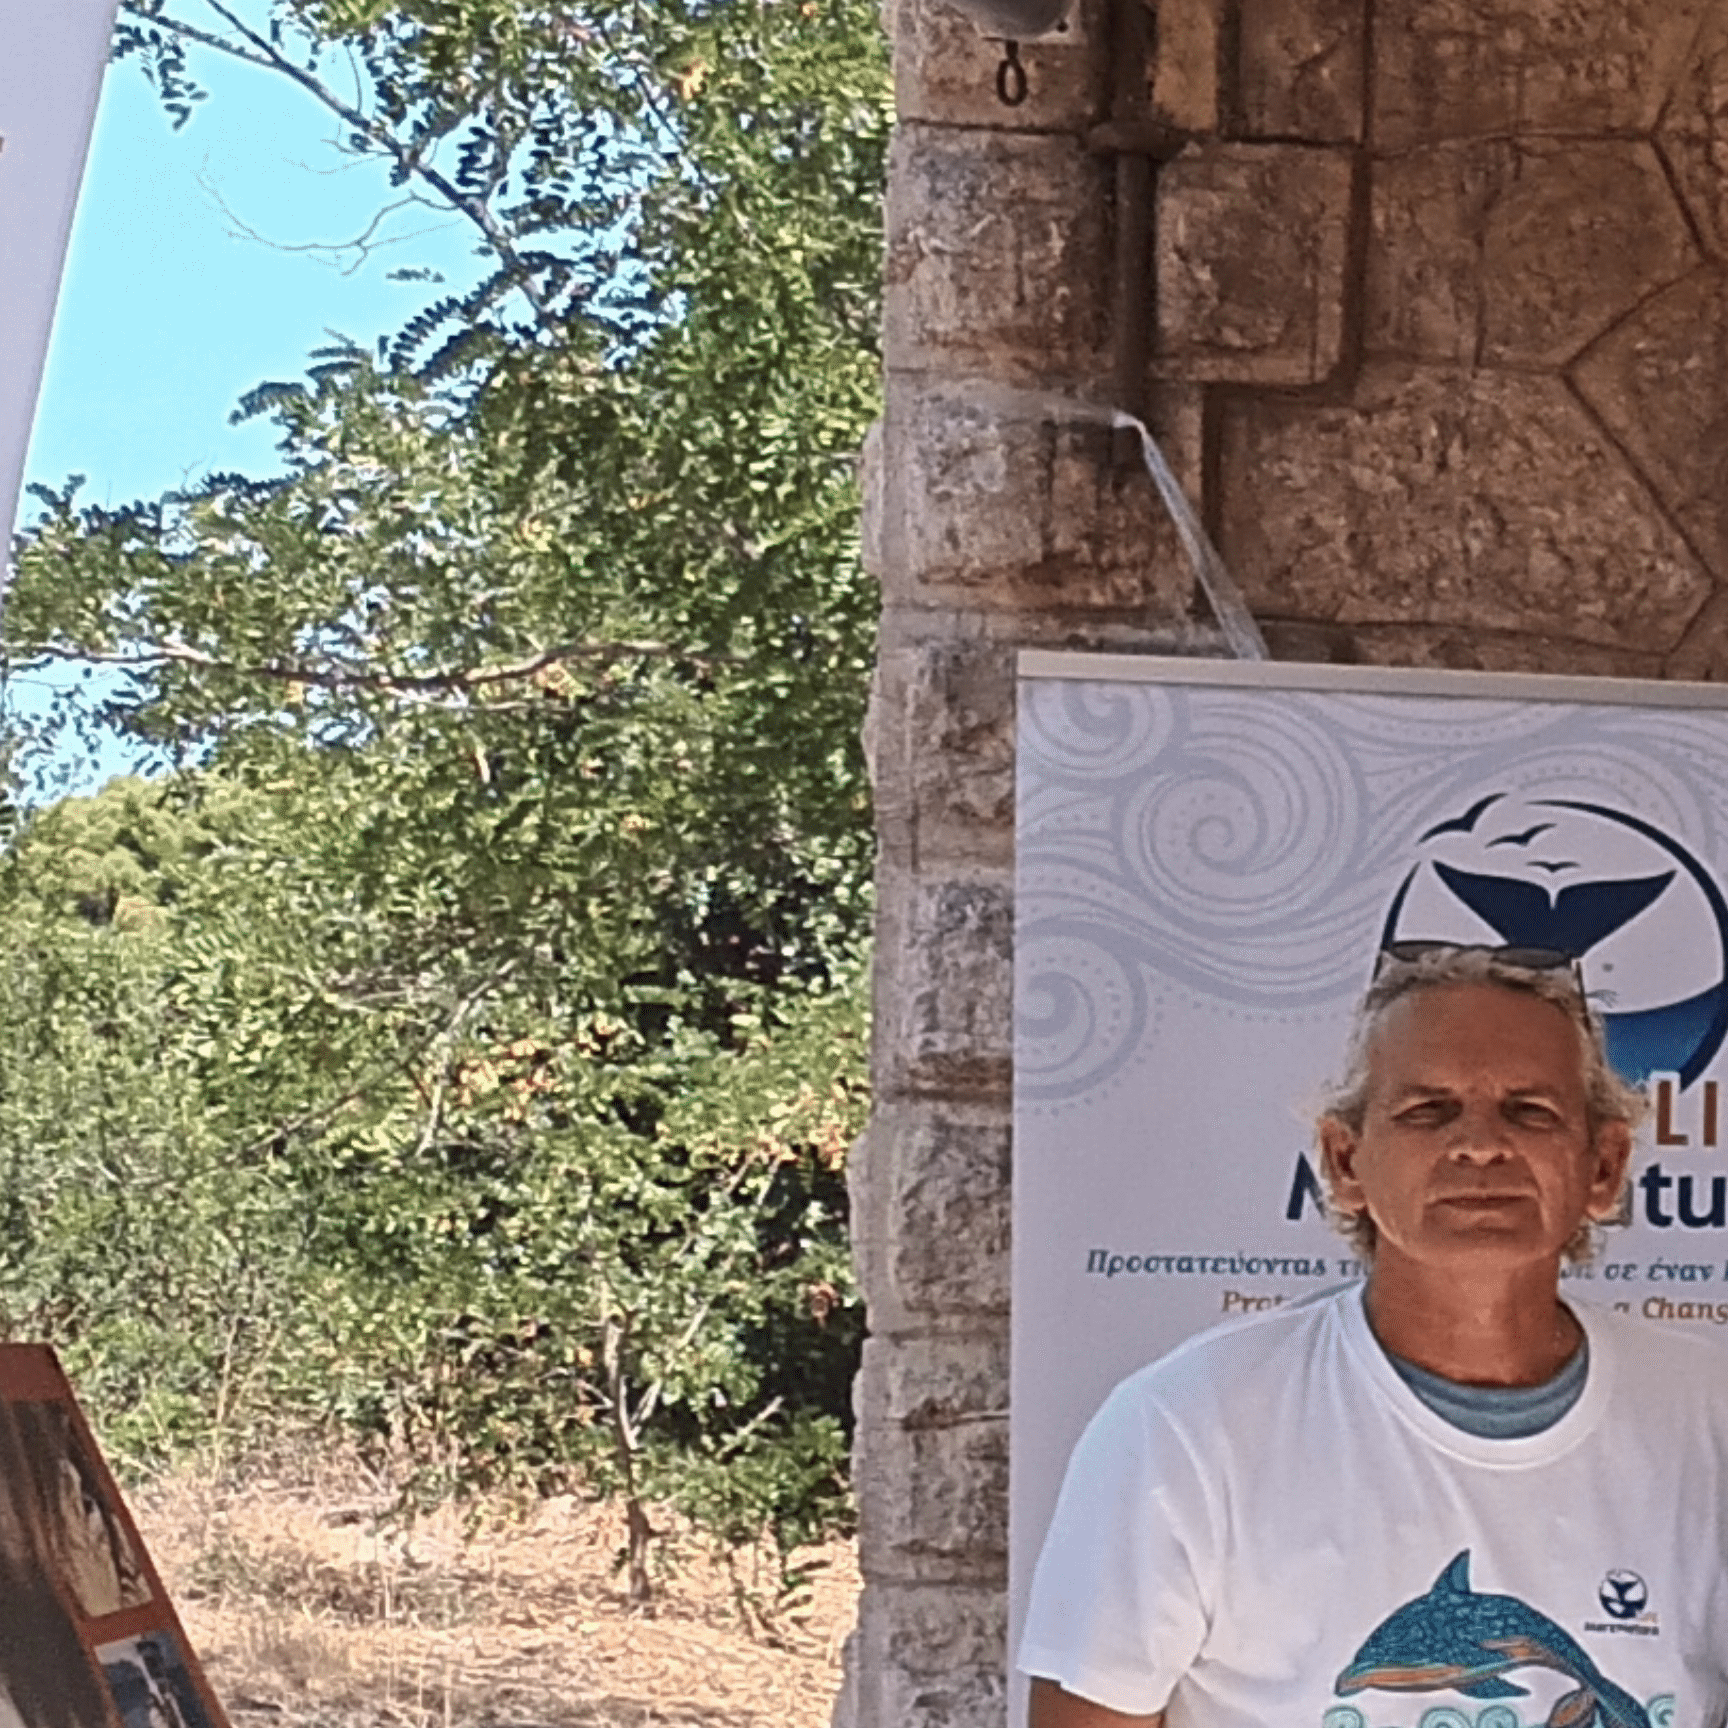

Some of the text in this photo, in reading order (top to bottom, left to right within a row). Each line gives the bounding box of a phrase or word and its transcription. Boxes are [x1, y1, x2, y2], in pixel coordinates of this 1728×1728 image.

[1086, 1249, 1327, 1279] Προστατεύοντας
[1604, 1263, 1638, 1281] σε
[1647, 1257, 1712, 1283] έναν
